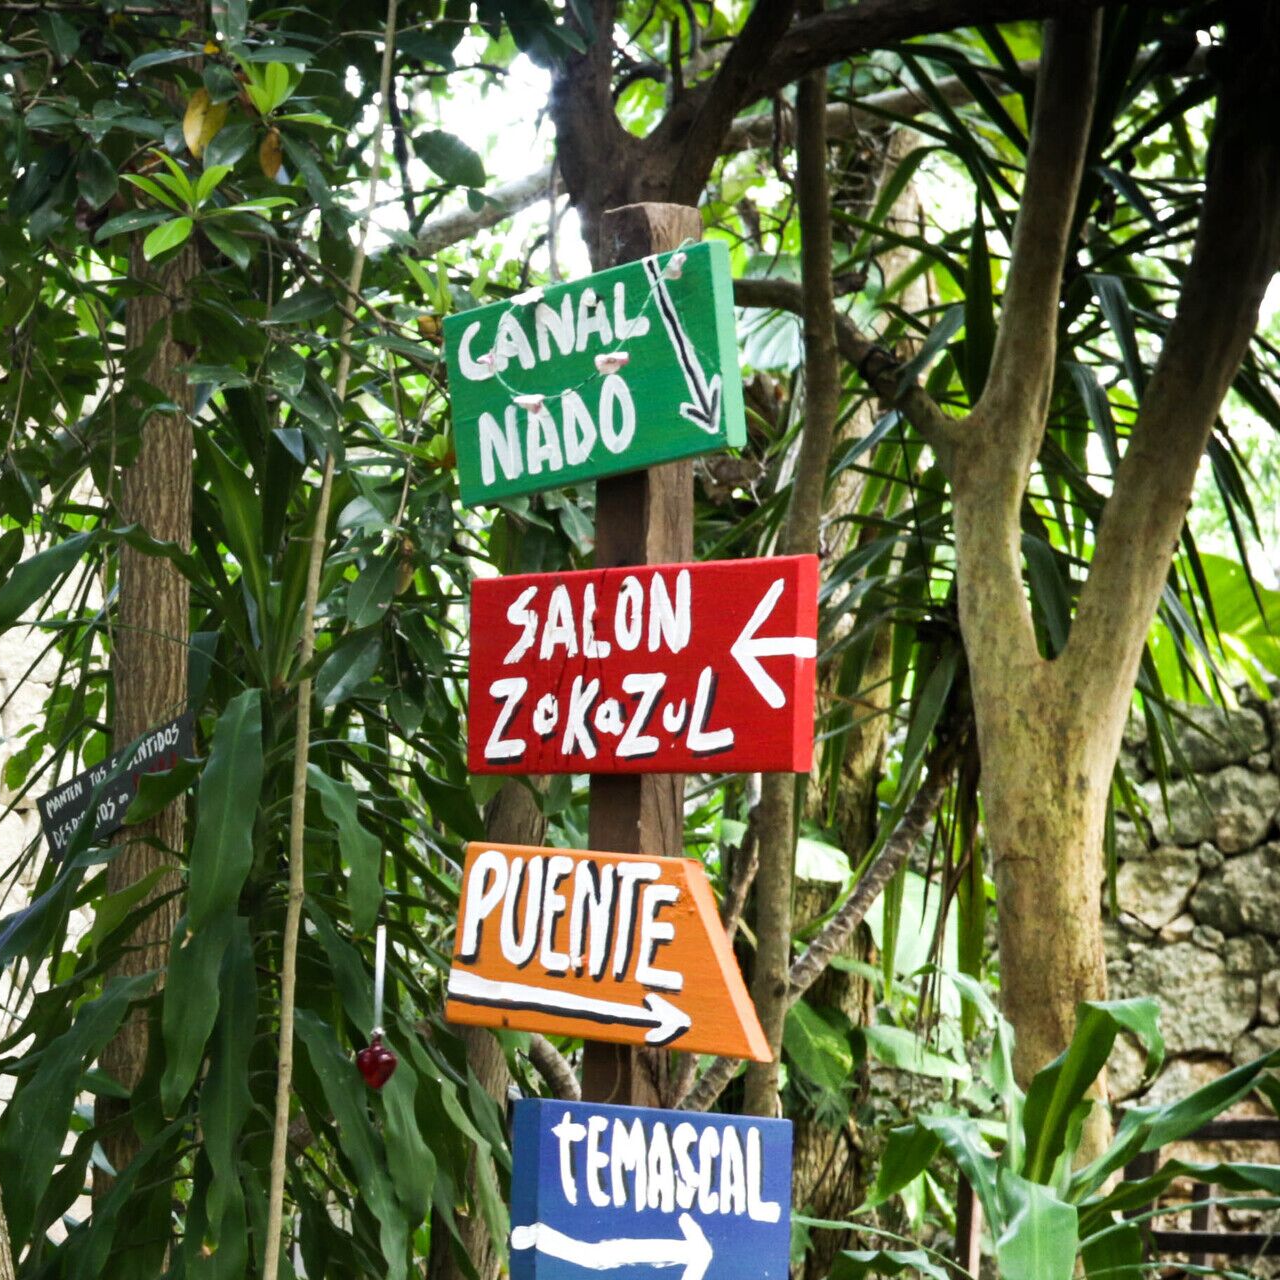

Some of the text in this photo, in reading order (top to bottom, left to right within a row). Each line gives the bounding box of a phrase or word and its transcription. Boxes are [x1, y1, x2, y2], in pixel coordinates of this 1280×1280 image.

[458, 282, 650, 381] CANAL
[478, 374, 636, 486] NADO
[503, 568, 692, 665] SALON
[46, 781, 83, 819] MANTEN
[89, 766, 107, 787] TUS
[459, 851, 684, 991] PUENTE
